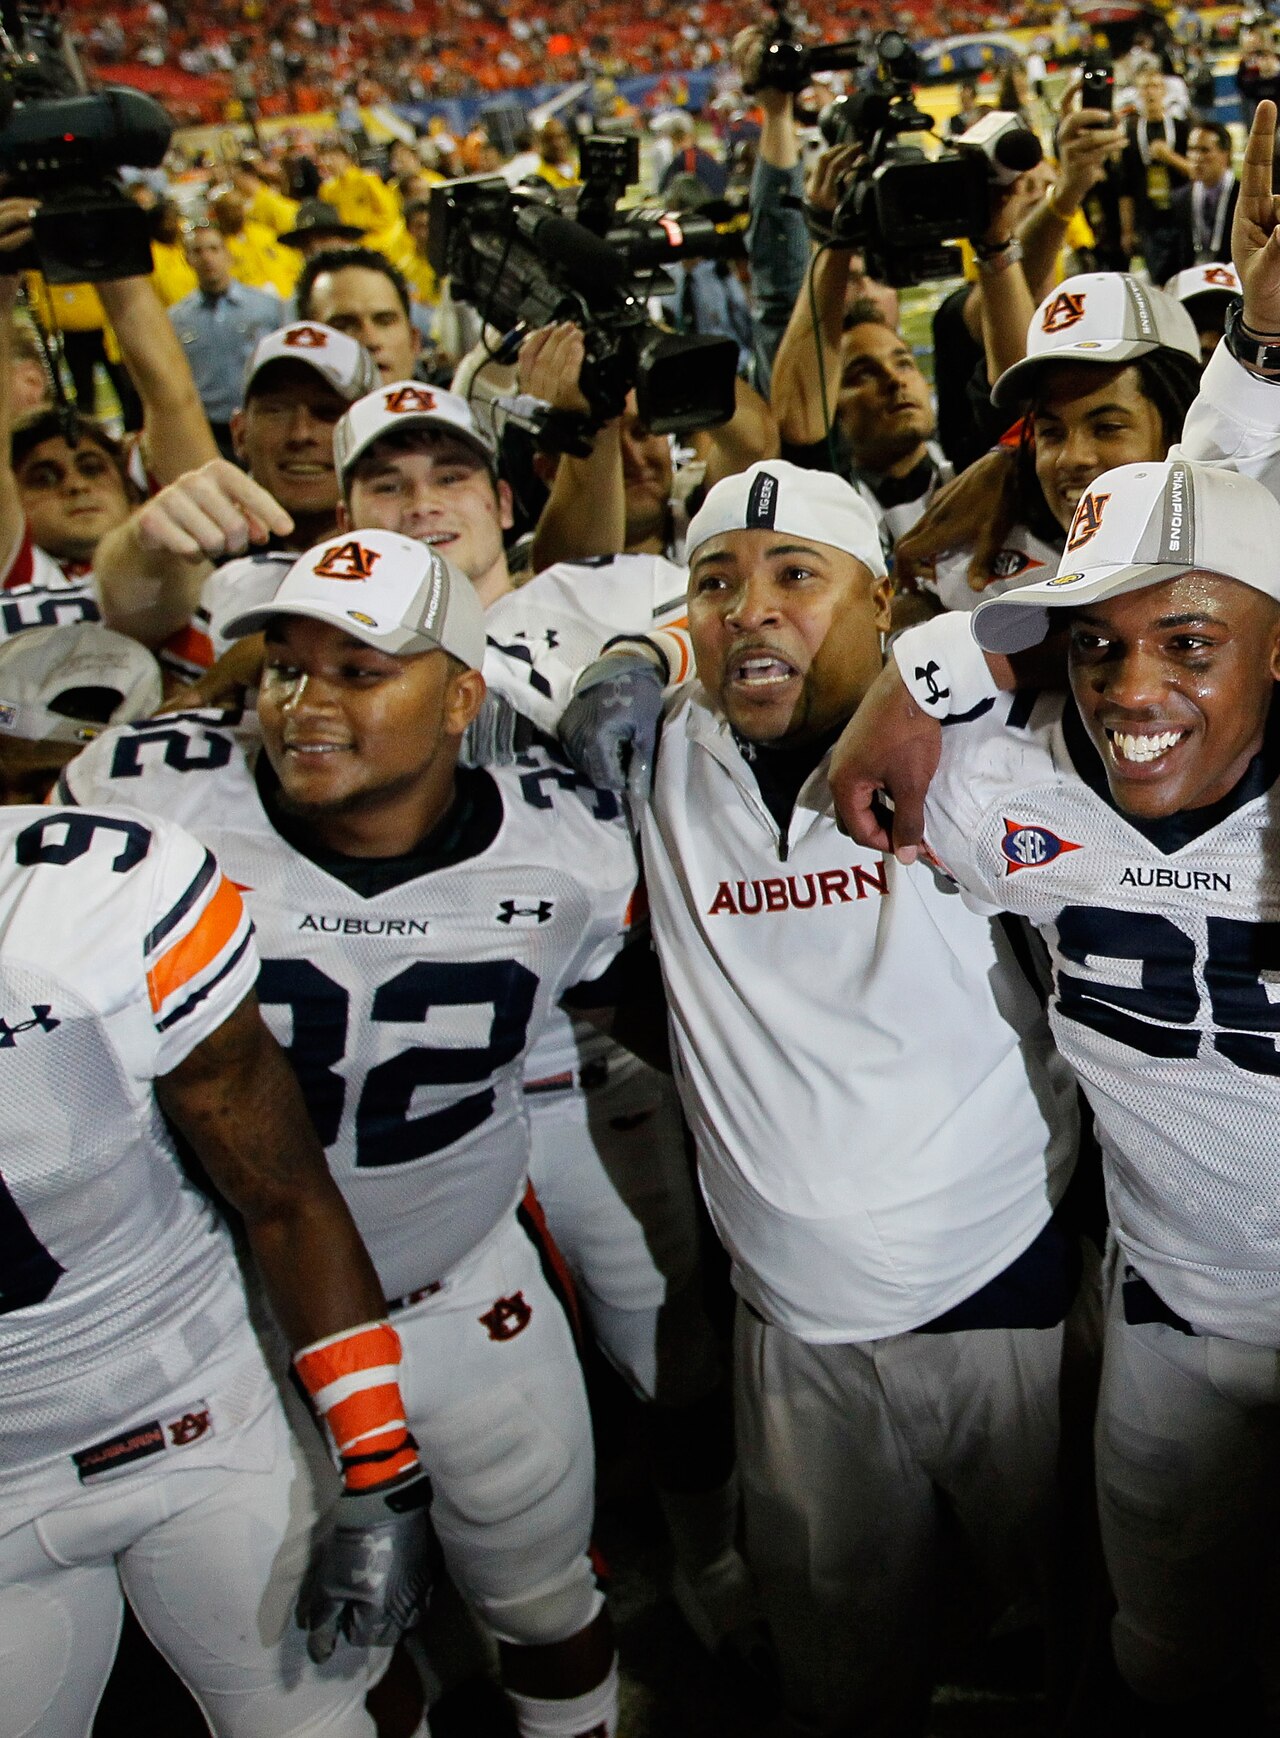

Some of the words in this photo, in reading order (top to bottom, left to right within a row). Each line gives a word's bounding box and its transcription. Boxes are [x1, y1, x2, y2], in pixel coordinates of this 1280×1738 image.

[757, 476, 775, 518] TIGERS
[1168, 470, 1184, 552] CHAMPIONS
[1012, 827, 1049, 863] SEC
[707, 861, 890, 916] AUBURN
[1118, 866, 1232, 893] AUBURN
[299, 913, 430, 936] AUBURN
